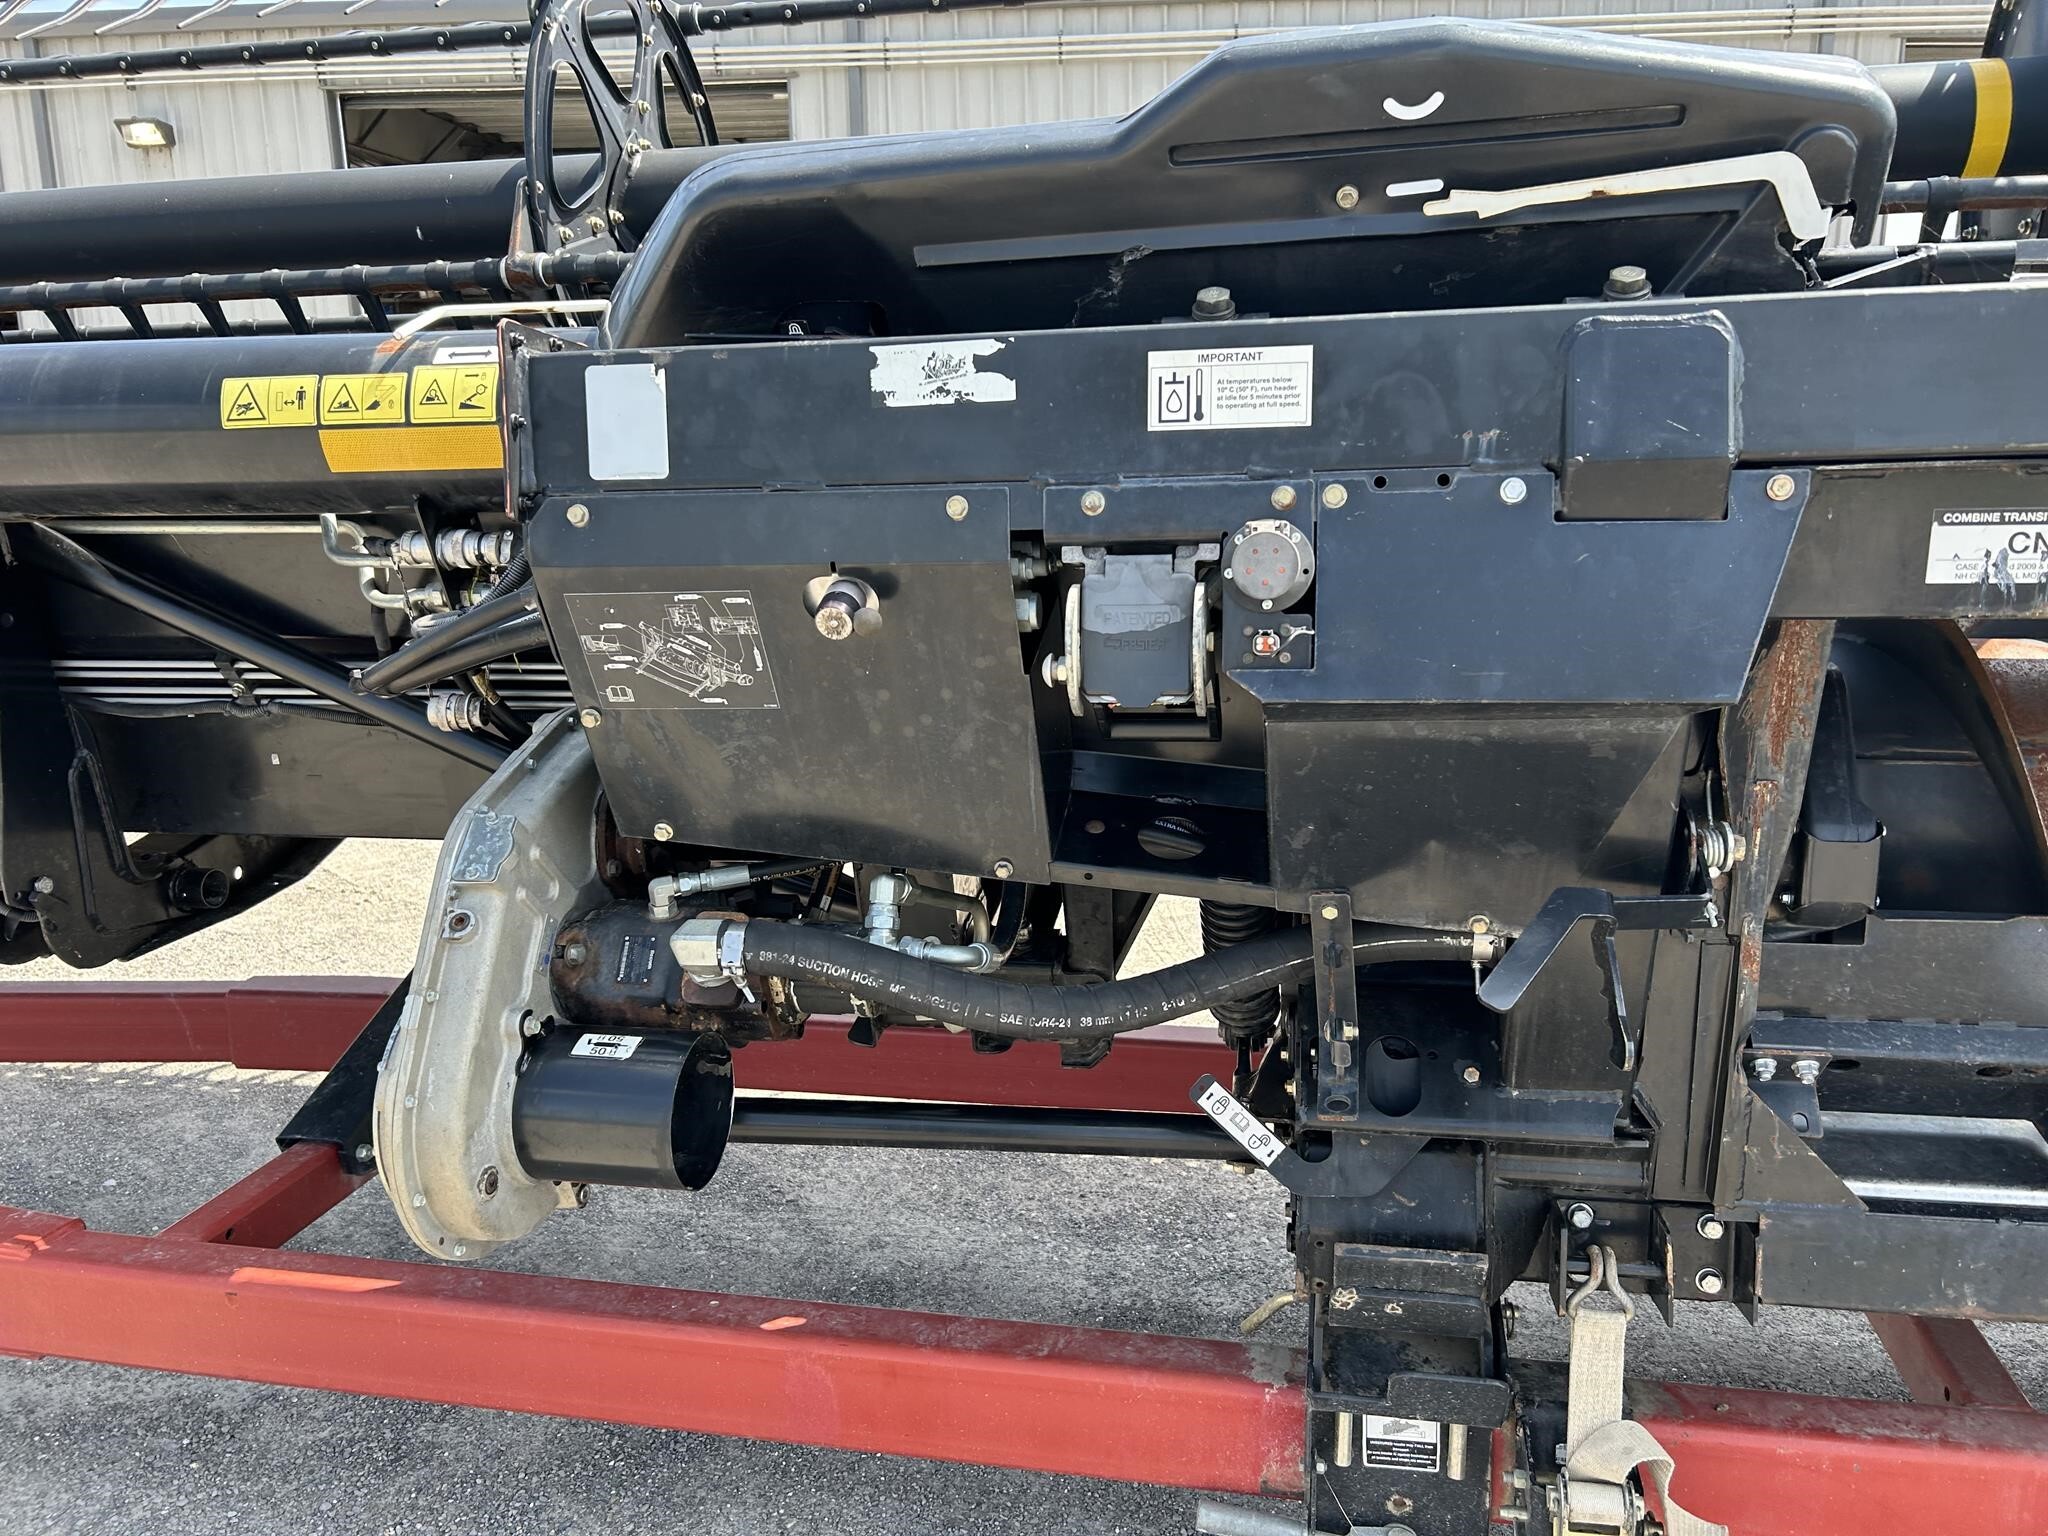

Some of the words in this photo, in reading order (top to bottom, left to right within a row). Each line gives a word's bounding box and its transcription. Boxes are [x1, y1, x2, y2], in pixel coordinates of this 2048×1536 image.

[1198, 352, 1263, 363] IMPORTANT
[1226, 378, 1270, 386] temperatures
[1284, 393, 1301, 401] prior
[1225, 402, 1257, 410] operating
[1279, 401, 1301, 409] speed.
[1943, 512, 2001, 523] COMBINE
[2003, 511, 2048, 522] TRANSI
[1955, 563, 1979, 571] CASE
[2016, 563, 2037, 571] 2009
[797, 956, 850, 978] SUCTION
[1000, 1013, 1023, 1026] SAE
[1080, 1016, 1093, 1027] 38
